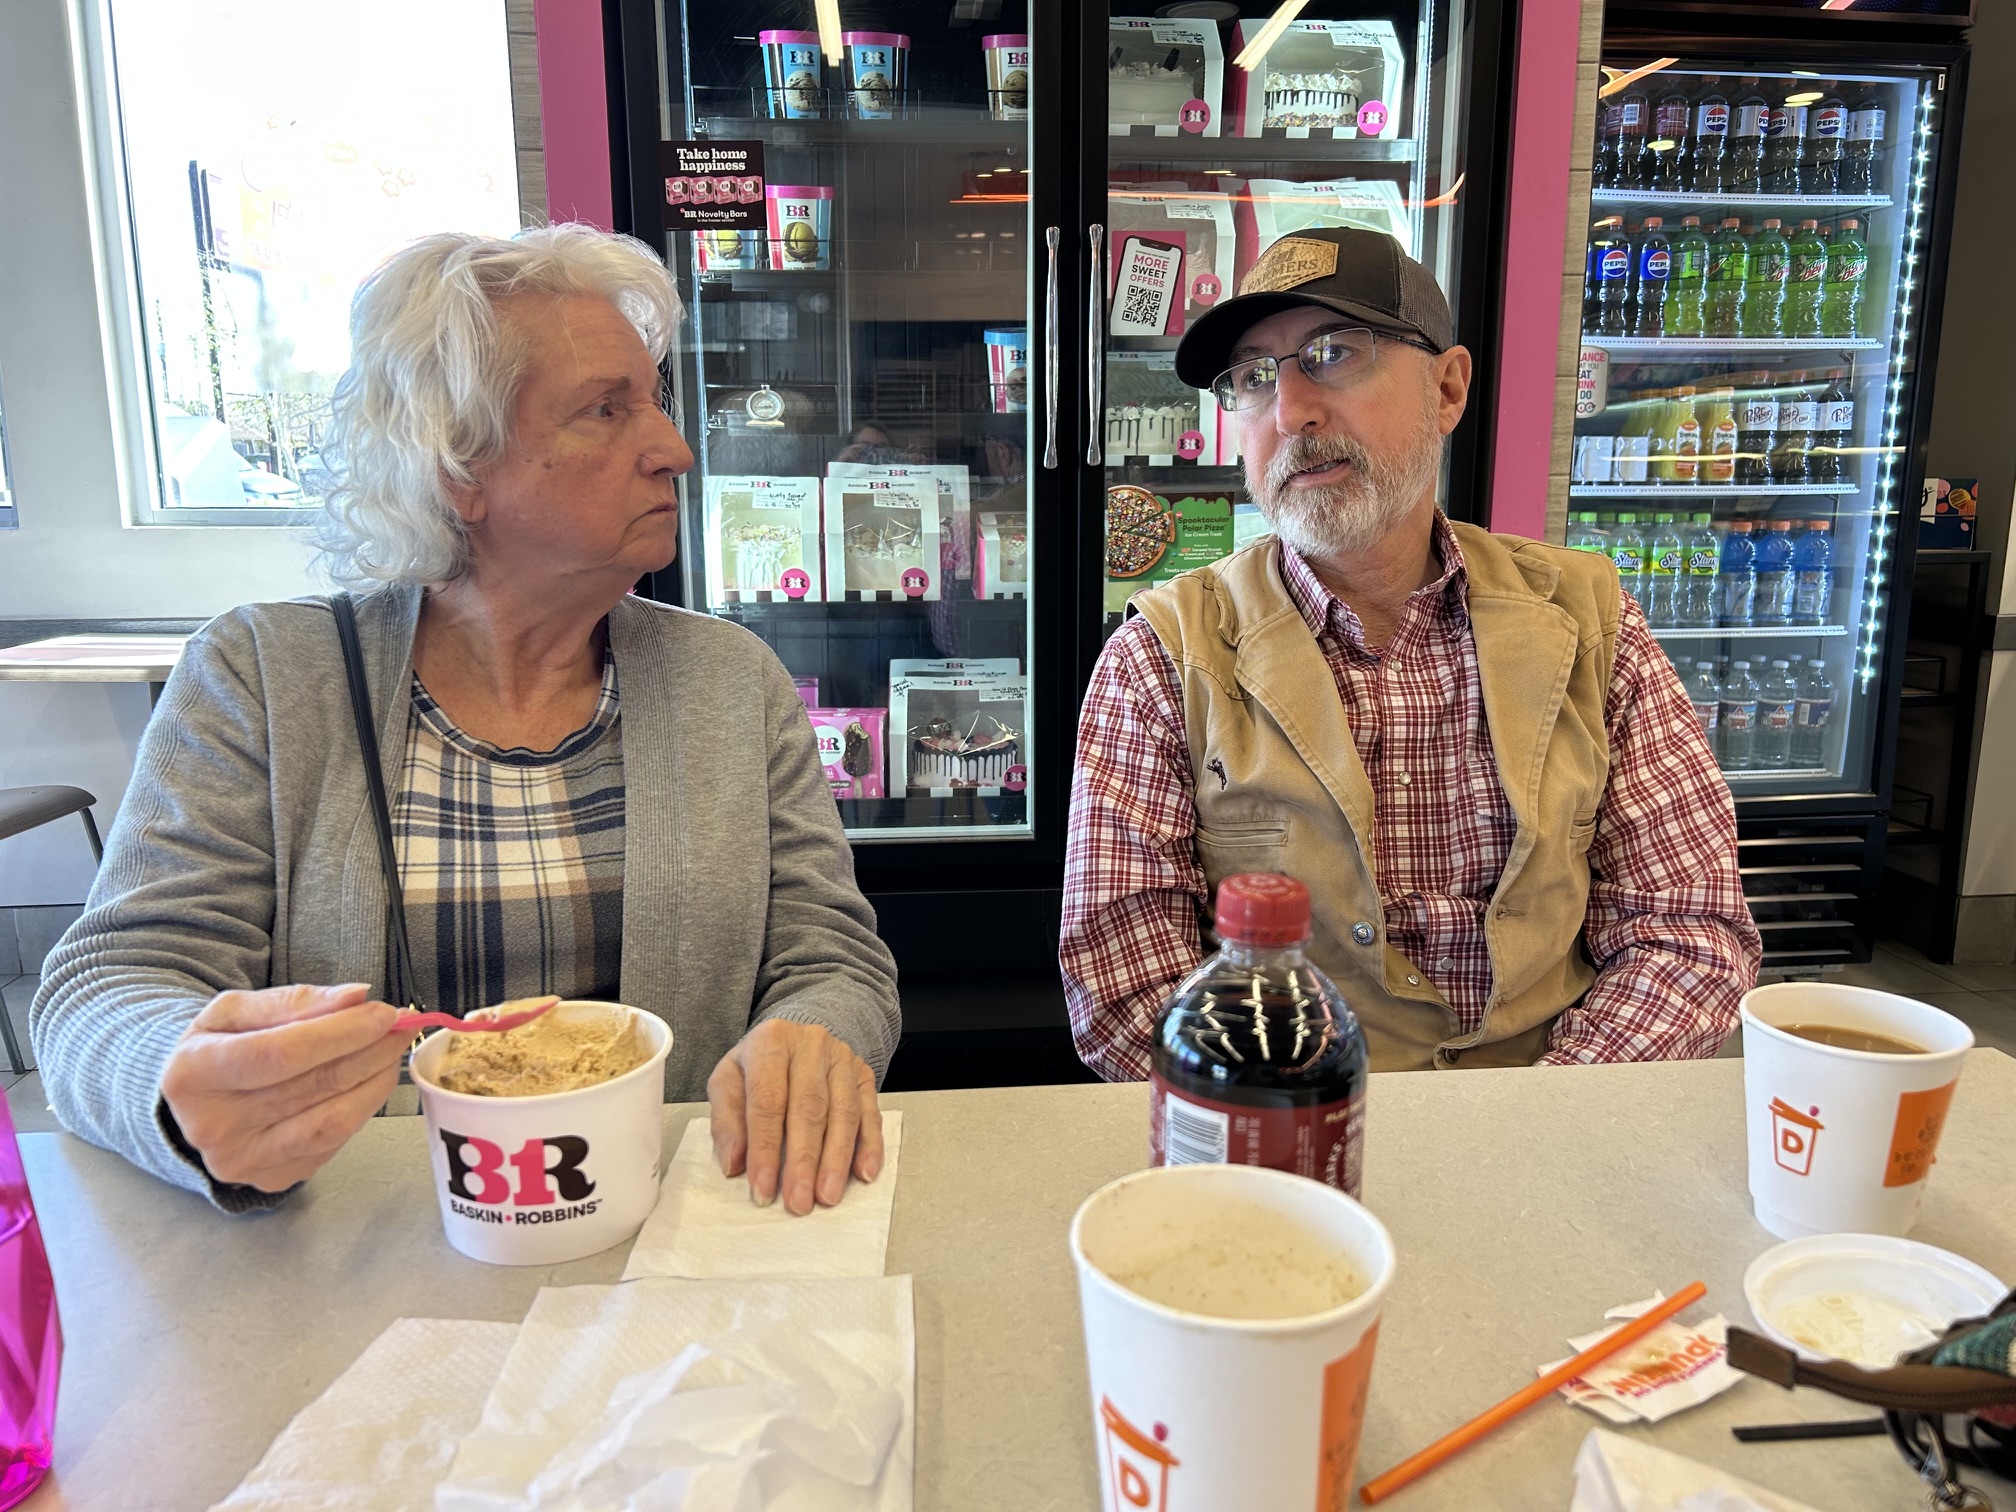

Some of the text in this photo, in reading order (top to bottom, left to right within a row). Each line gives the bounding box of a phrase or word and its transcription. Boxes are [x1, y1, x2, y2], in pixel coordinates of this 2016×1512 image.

[790, 51, 814, 64] BR
[862, 52, 886, 64] BR
[1184, 110, 1206, 122] BR
[1363, 112, 1383, 124] BR
[677, 148, 747, 159] Take home
[680, 160, 746, 173] happiness
[698, 211, 729, 219] Novelty
[786, 205, 810, 217] BR
[1134, 254, 1169, 270] MORE
[1131, 265, 1167, 279] SWEET
[1130, 274, 1164, 288] OFFERS
[1195, 284, 1217, 294] BR
[1579, 370, 1592, 379] AT
[1580, 391, 1591, 399] DO
[1746, 410, 1771, 423] Pepper
[1180, 439, 1200, 449] BR
[784, 577, 806, 588] BR
[904, 577, 925, 588] BR
[870, 787, 876, 796] 4
[1781, 1128, 1803, 1154] D
[440, 1127, 596, 1206] BR
[451, 1198, 597, 1224] BASKIN ROBBINS
[1118, 1456, 1151, 1508] D
